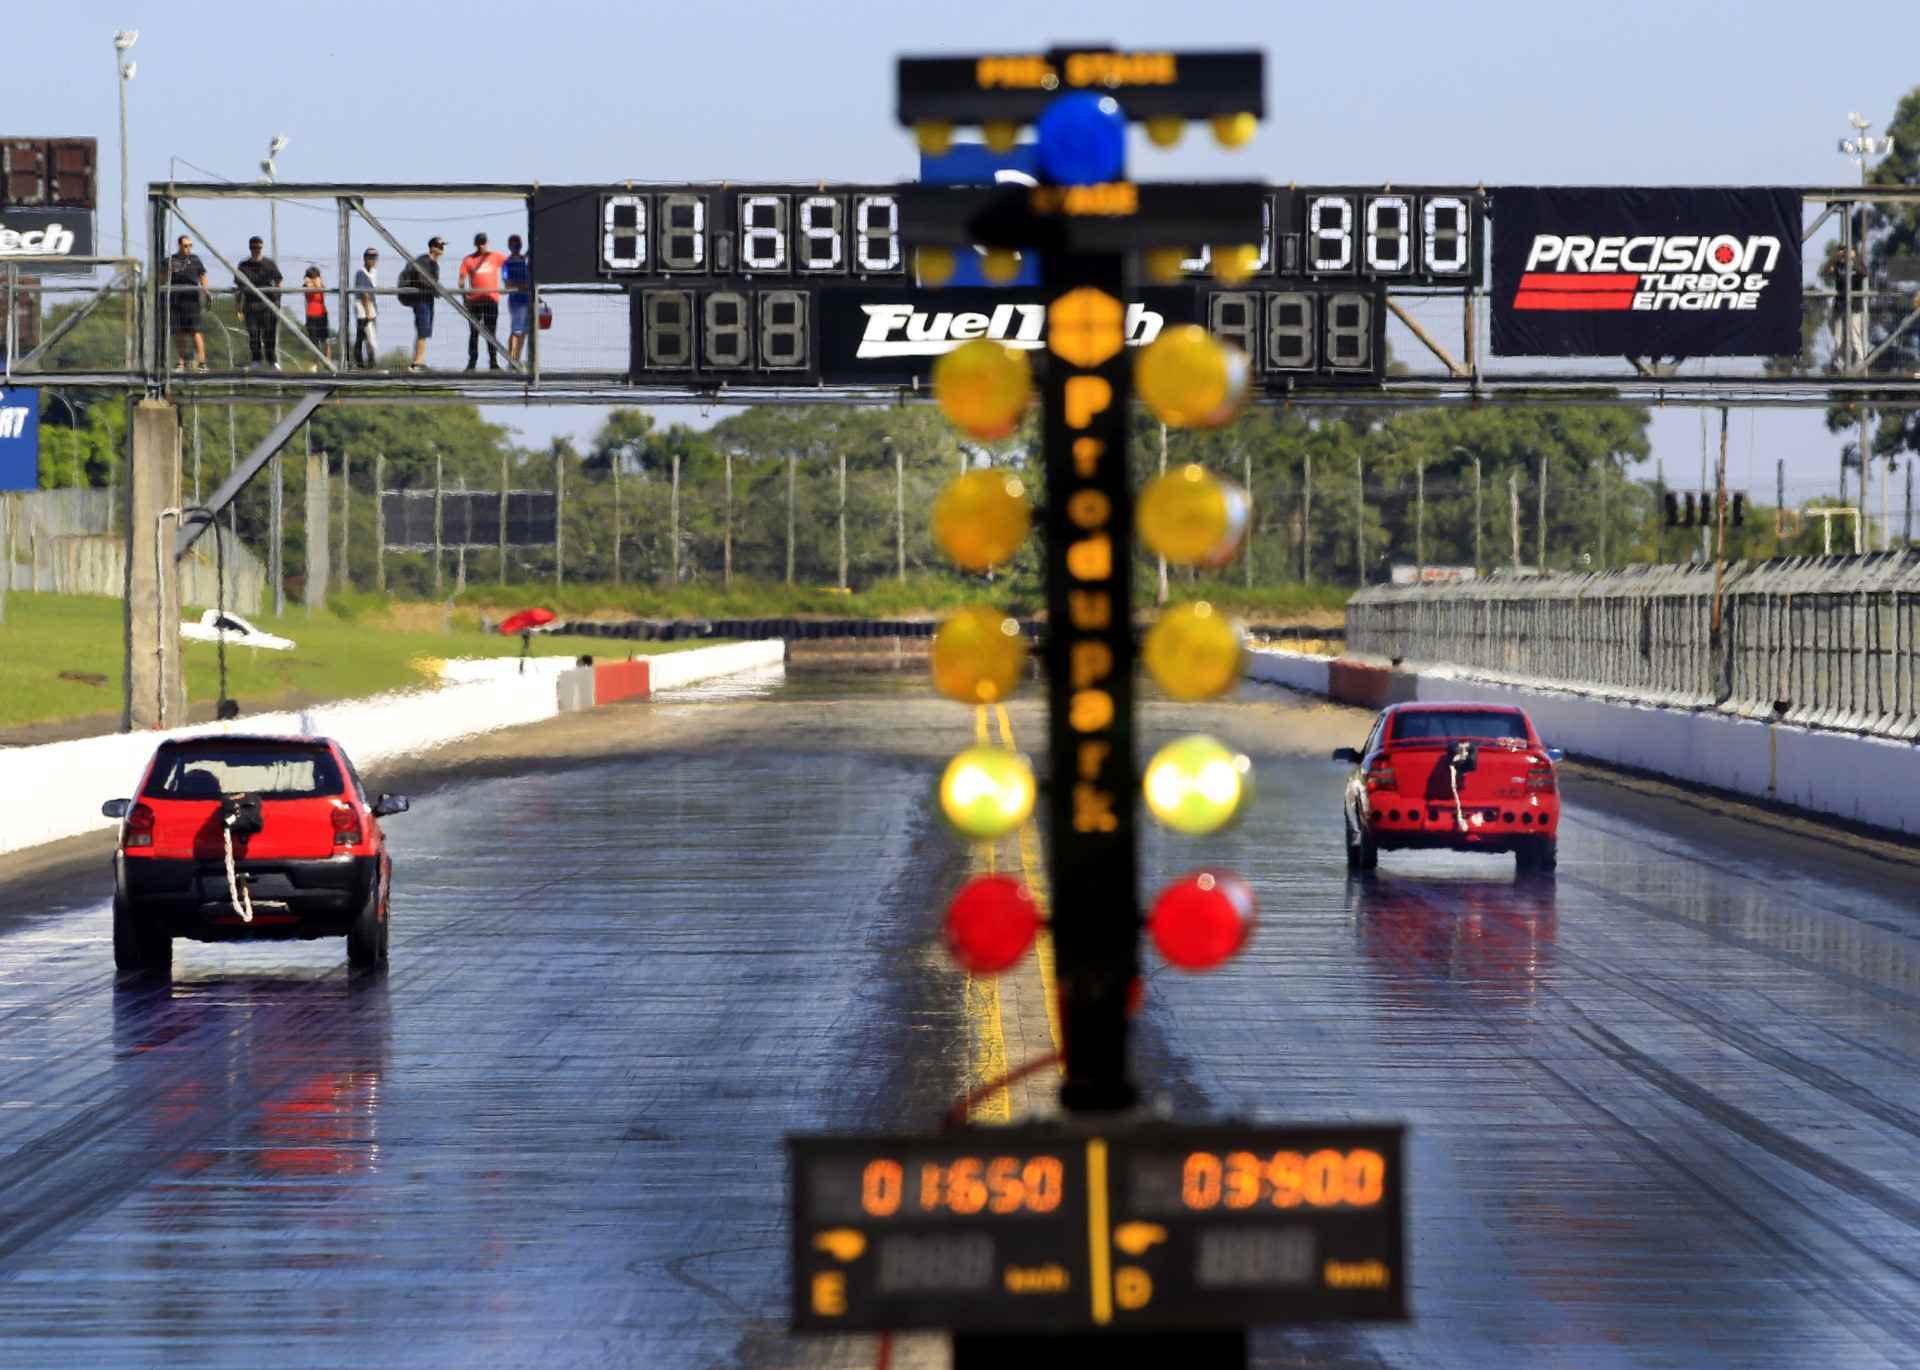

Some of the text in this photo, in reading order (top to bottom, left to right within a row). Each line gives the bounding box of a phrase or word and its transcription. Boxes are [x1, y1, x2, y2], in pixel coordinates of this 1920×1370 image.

[1525, 234, 1781, 273] PRECISION
[1640, 273, 1768, 292] TURBO &
[1632, 292, 1760, 310] ENGINE
[857, 303, 1164, 348] FuelTh
